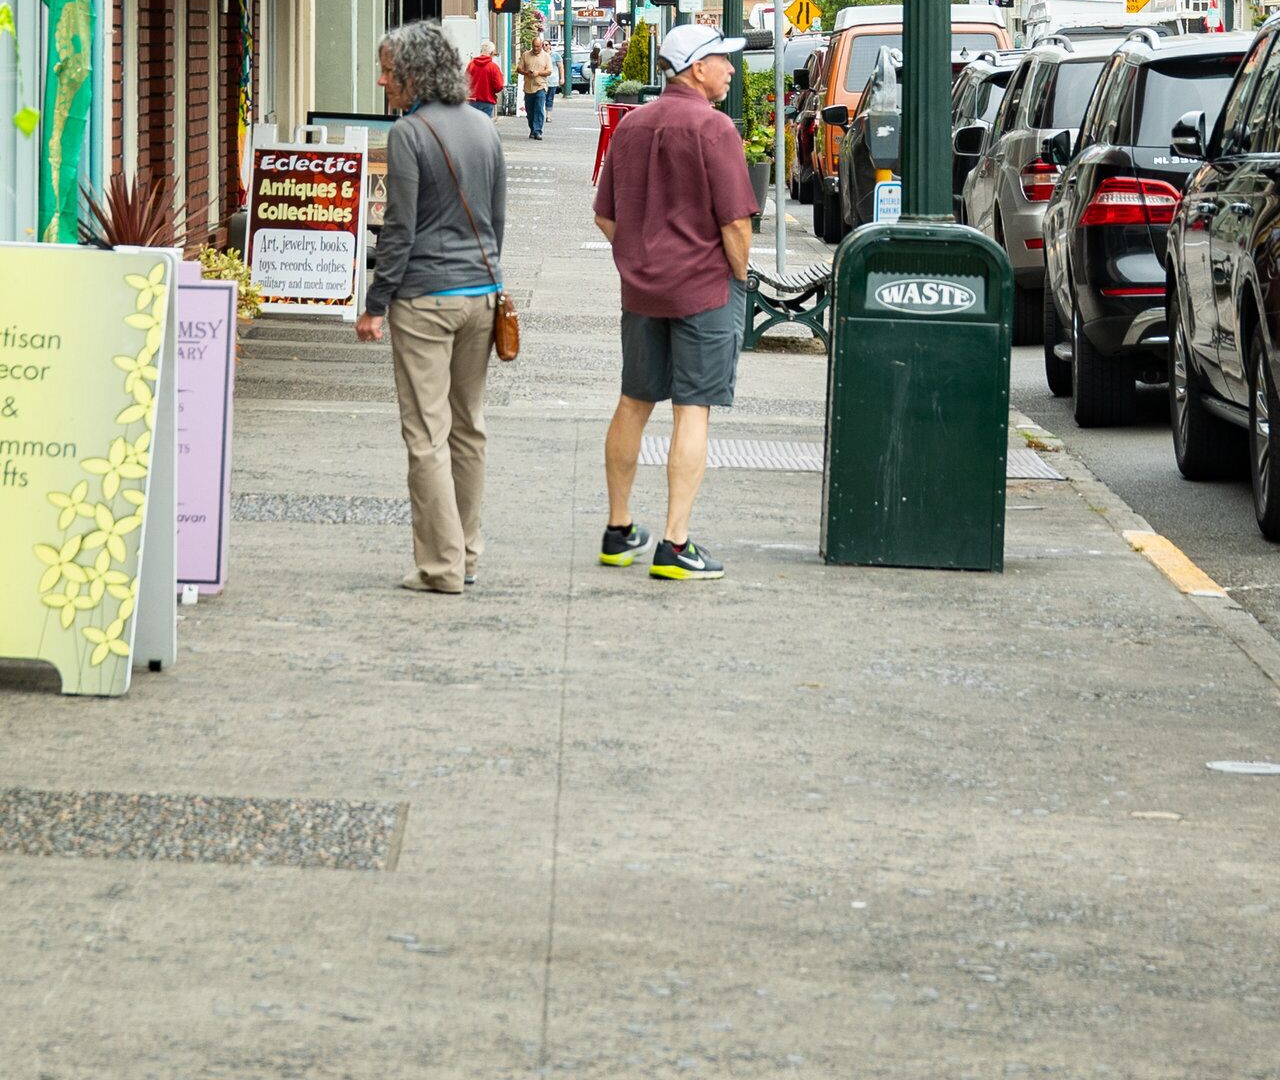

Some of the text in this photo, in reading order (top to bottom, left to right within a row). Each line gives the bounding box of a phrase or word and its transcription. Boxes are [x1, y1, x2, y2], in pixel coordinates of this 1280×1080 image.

[259, 155, 358, 174] Eclectic
[259, 178, 355, 201] Antiques &
[257, 202, 353, 223] Collectibles
[288, 277, 303, 290] and
[304, 277, 324, 290] much
[325, 278, 347, 291] more!
[880, 282, 971, 306] WASTE
[0, 395, 19, 418] &
